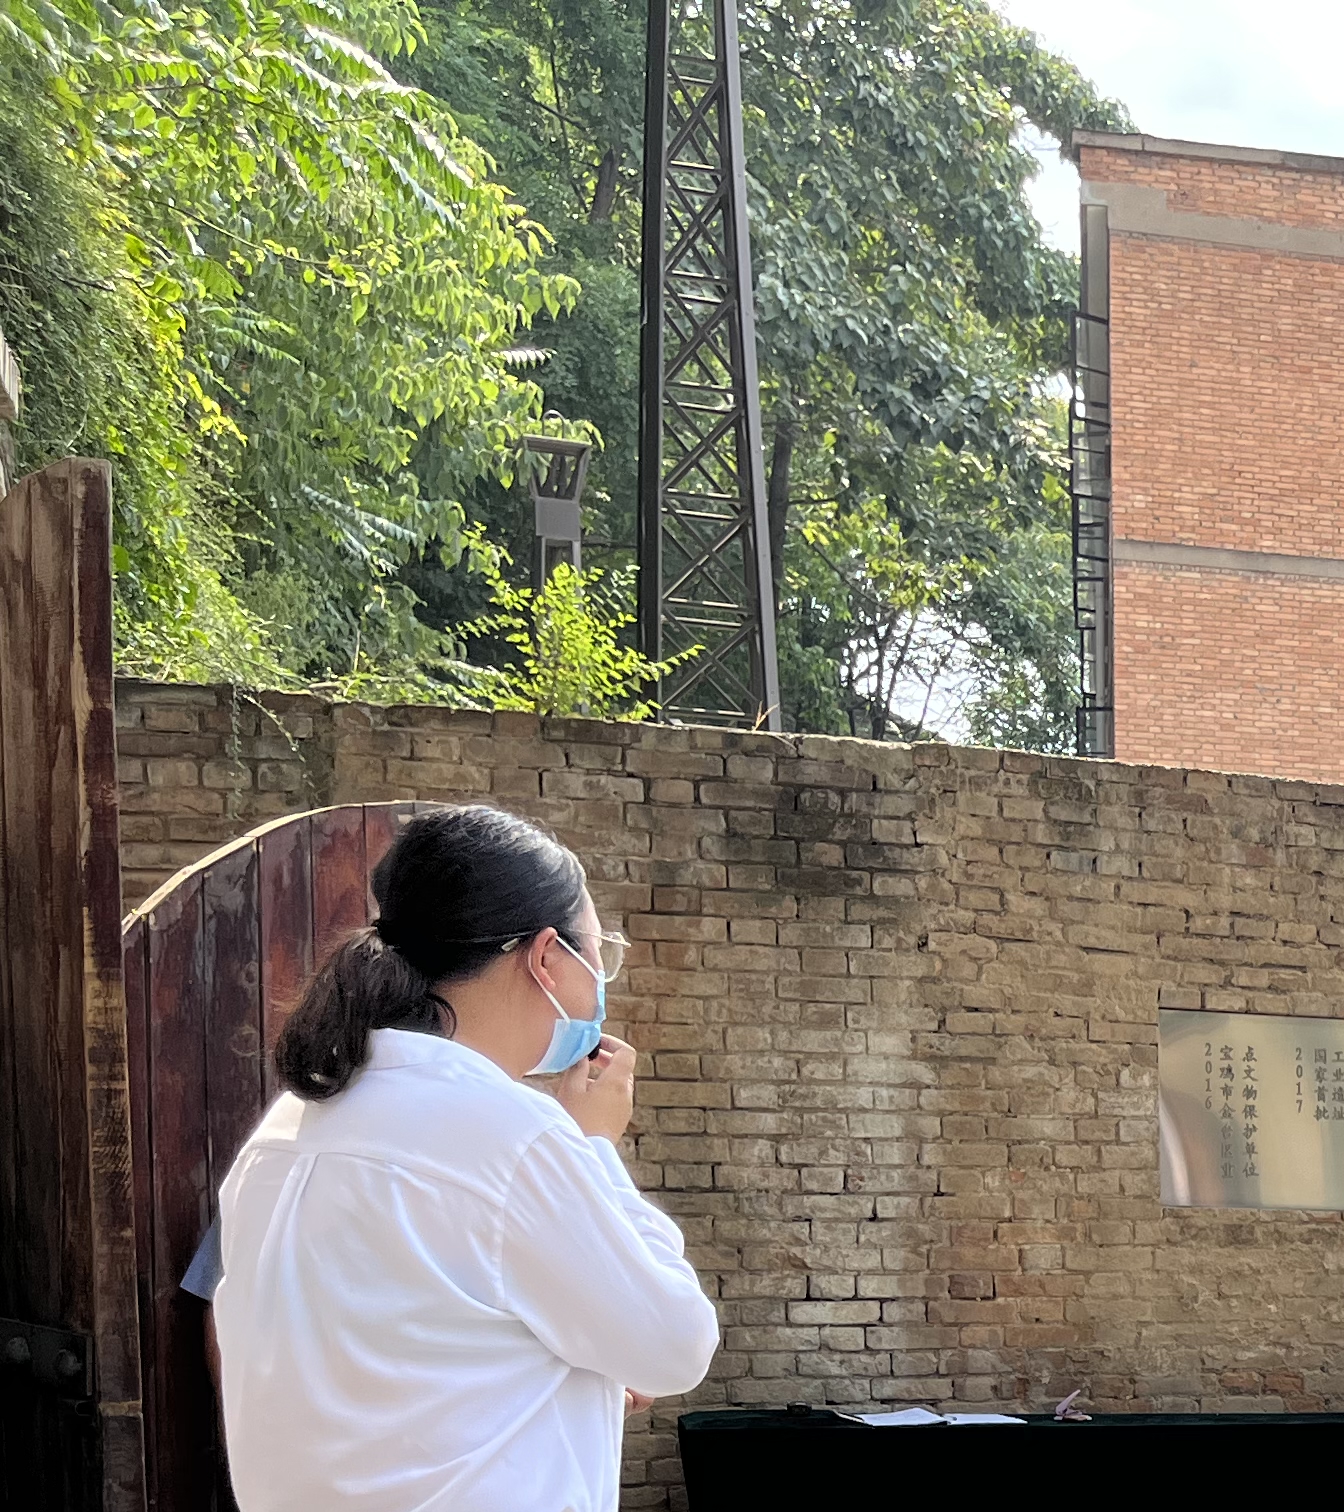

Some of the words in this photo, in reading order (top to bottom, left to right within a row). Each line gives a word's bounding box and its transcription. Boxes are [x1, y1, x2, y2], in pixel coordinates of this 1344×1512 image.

[1204, 1042, 1213, 1110] 2016
[1295, 1047, 1303, 1114] 2017
[1313, 1048, 1330, 1122] 国家首批
[1242, 1045, 1259, 1179] 点文物保护单位
